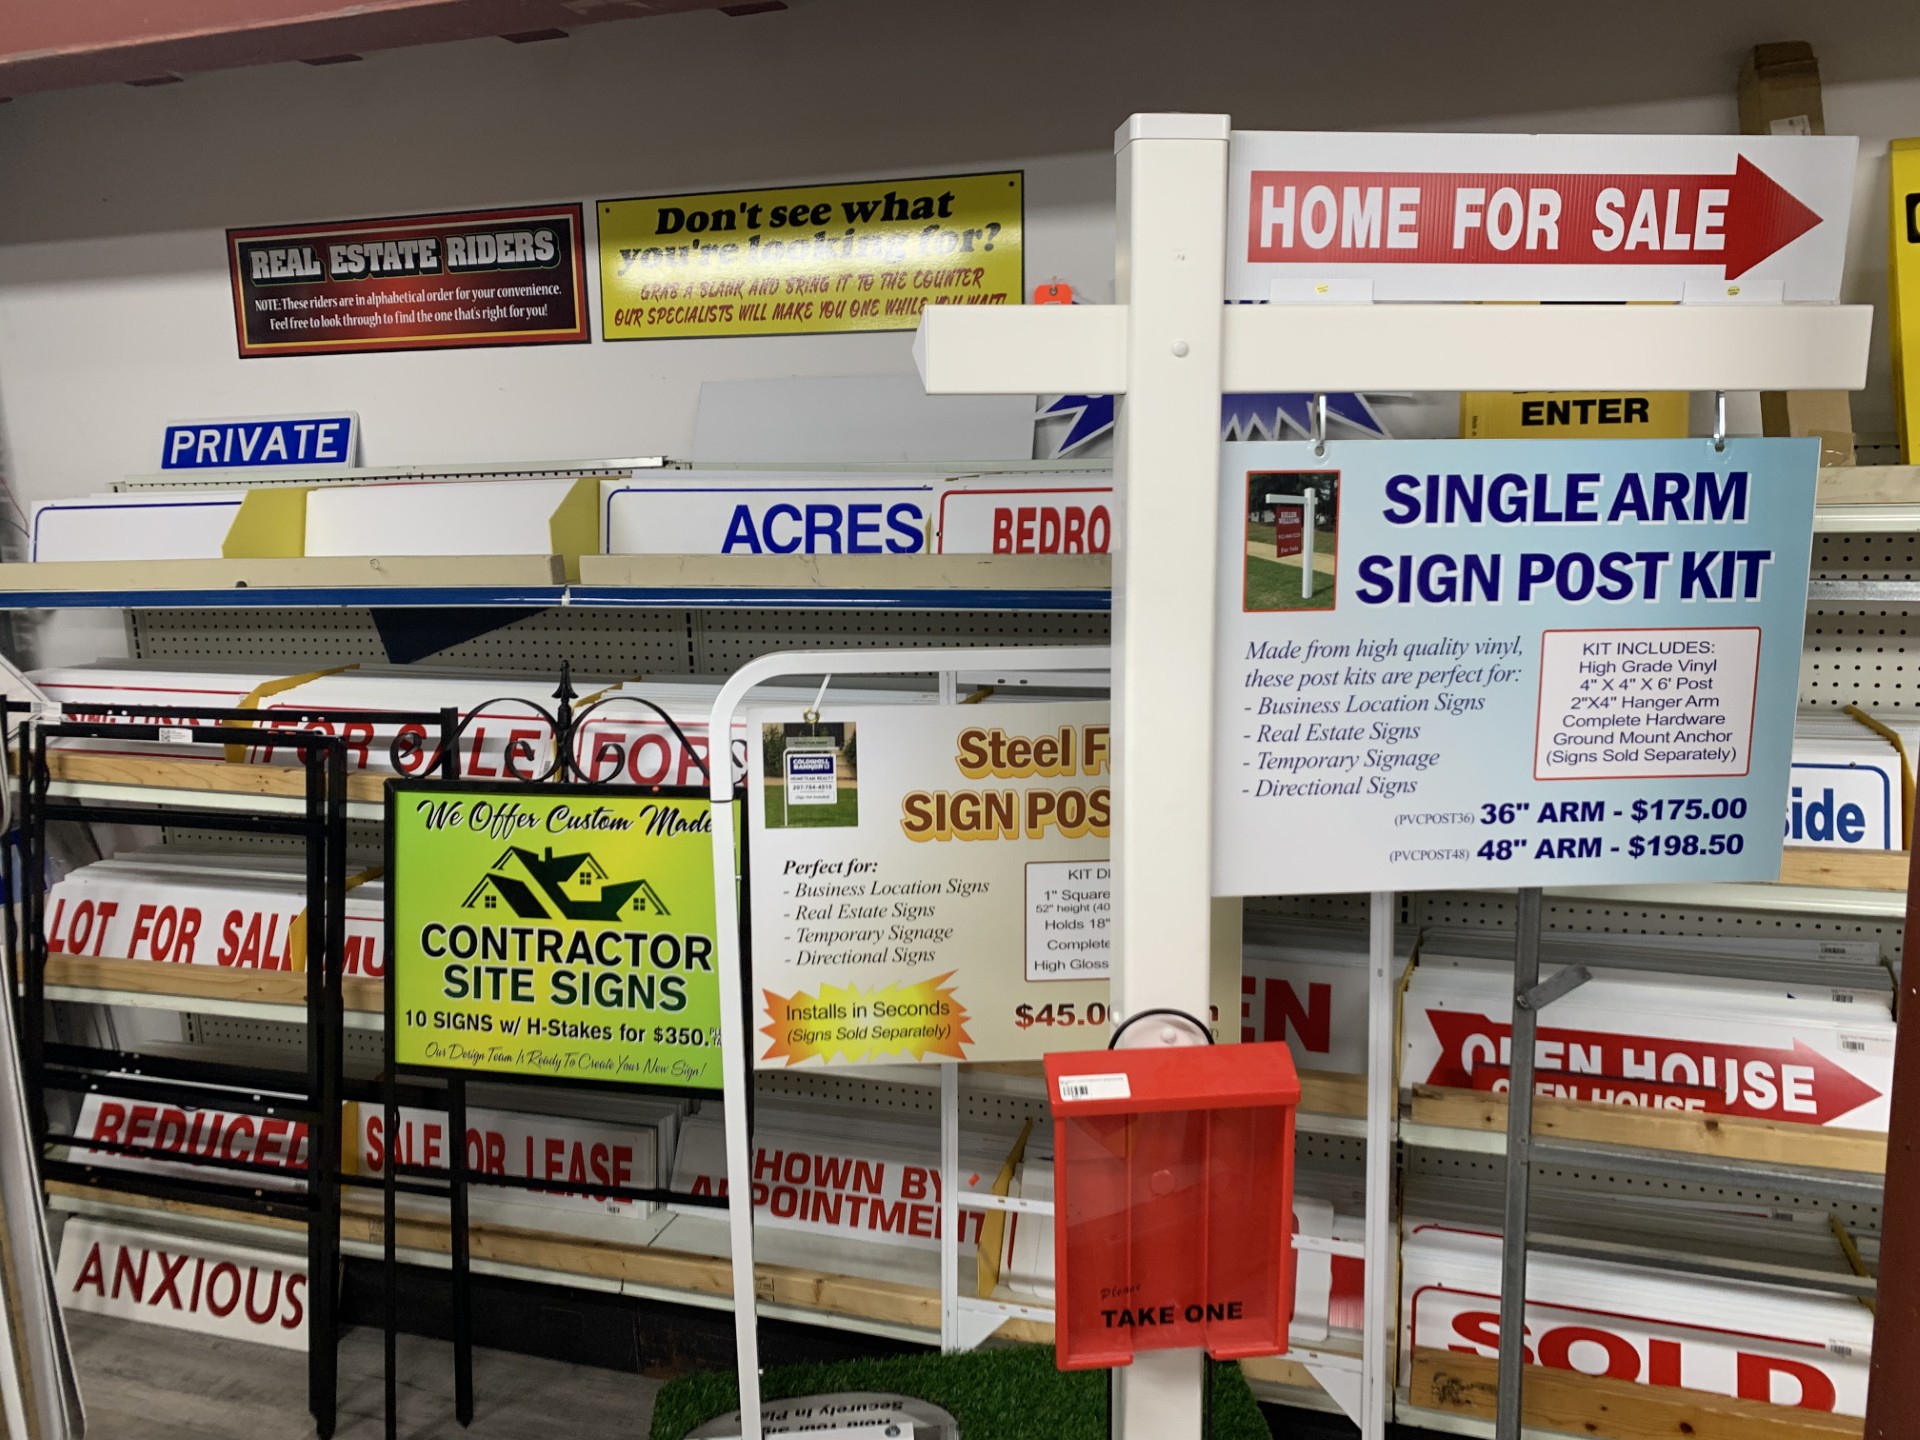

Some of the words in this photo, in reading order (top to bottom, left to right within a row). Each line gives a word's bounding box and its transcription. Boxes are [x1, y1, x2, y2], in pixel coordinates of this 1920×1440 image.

[655, 202, 763, 234] Don't
[769, 202, 832, 228] see
[841, 190, 955, 223] what
[1259, 185, 1421, 250] HOME
[1452, 187, 1562, 251] FOR
[1591, 187, 1731, 252] SALE
[250, 246, 323, 281] REAL
[328, 238, 439, 276] ESTATE
[445, 230, 556, 269] RIDERS
[618, 239, 740, 276] you're
[747, 227, 910, 265] looking
[918, 222, 1002, 255] for?
[255, 298, 281, 312] NOTE:
[281, 296, 308, 310] These
[309, 294, 338, 309] riders
[366, 289, 425, 308] alphabetical
[426, 288, 454, 302] order
[471, 288, 498, 302] your
[497, 283, 562, 298] convenience.
[641, 281, 681, 302] GRAB
[700, 279, 744, 299] BLANK
[748, 276, 780, 296] AND
[785, 274, 830, 295] BRING
[880, 271, 907, 290] THE
[913, 267, 985, 289] COUNTER
[270, 317, 288, 331] Feel
[289, 317, 308, 330] free
[321, 314, 343, 328] look
[343, 312, 382, 328] through
[394, 310, 415, 324] find
[454, 306, 481, 320] that's
[482, 305, 507, 323] right
[526, 303, 548, 320] you!
[614, 307, 644, 328] OUR
[647, 304, 734, 326] SPECIALISTS
[738, 303, 768, 322] WILL
[772, 301, 814, 323] MAKE
[819, 300, 847, 319] YOU
[850, 298, 880, 318] ONE
[885, 296, 929, 317] WHILE
[1521, 397, 1650, 426] ENTER
[170, 422, 342, 465] PRIVATE
[1382, 472, 1602, 526] SINGLE
[1607, 471, 1751, 524] ARM
[721, 501, 925, 554] ACRES
[1355, 552, 1504, 605] SIGN
[1517, 550, 1673, 602] POST
[1680, 549, 1774, 601] KIT
[1244, 640, 1301, 660] Made
[1301, 639, 1351, 663] from
[1355, 638, 1398, 662] high
[1403, 636, 1470, 661] quality
[1474, 635, 1523, 660] vinyl,
[1582, 642, 1612, 656] KIT
[1617, 641, 1715, 655] INCLUDES:
[1244, 669, 1294, 688] these
[1297, 670, 1340, 692] post
[1343, 666, 1377, 686] kits
[1381, 670, 1413, 685] are
[1415, 666, 1483, 689] perfect
[1483, 663, 1523, 687] for:
[1579, 660, 1616, 676] High
[1621, 660, 1673, 673] Grade
[1678, 659, 1717, 675] Vinyl
[1676, 677, 1713, 690] Post
[1257, 696, 1341, 715] Business
[1345, 694, 1429, 714] Location
[1434, 692, 1486, 715] Signs
[1621, 695, 1682, 711] Hanger
[1685, 694, 1719, 708] Arm
[1256, 723, 1302, 743] Real
[1305, 723, 1365, 742] Estate
[1369, 721, 1421, 744] Signs
[1562, 714, 1641, 730] Complete
[1646, 713, 1726, 726] Hardware
[957, 727, 1074, 774] Steel
[1553, 732, 1615, 746] Ground
[1619, 731, 1671, 744] Mount
[1673, 730, 1733, 743] Anchor
[1257, 751, 1359, 774] Temporary
[1364, 749, 1440, 772] Signage
[1546, 750, 1598, 766] (Signs
[1602, 748, 1639, 763] Sold
[1644, 747, 1737, 764] Separately)
[1255, 776, 1364, 797] Directional
[1366, 776, 1418, 799] Signs
[416, 800, 464, 832] We
[469, 801, 541, 840] Offer
[545, 804, 635, 834] Custom
[639, 804, 713, 837] Made
[902, 791, 1018, 838] SIGN
[1394, 811, 1475, 827] (PVCPOST36)
[1480, 802, 1530, 824] 36"
[1536, 801, 1605, 823] ARM
[1630, 797, 1748, 823] $175.00
[1389, 848, 1470, 864] (PVCPOST48)
[1476, 838, 1527, 861] 48"
[1534, 837, 1602, 859] ARM
[1627, 833, 1744, 859] $198.50
[783, 859, 844, 878] Perfect
[844, 858, 878, 878] for:
[1068, 869, 1093, 880] KIT
[794, 882, 866, 898] Business
[870, 880, 942, 896] Location
[946, 878, 990, 898] Signs
[1061, 889, 1110, 902] Square
[795, 904, 833, 920] Real
[837, 903, 888, 919] Estate
[891, 902, 936, 921] Signs
[1057, 903, 1090, 914] height
[49, 898, 119, 957] LOT
[127, 903, 202, 964] FOR
[796, 927, 884, 945] Temporary
[888, 924, 954, 944] Signage
[1045, 919, 1084, 930] Holds
[420, 922, 714, 972] CONTRACTOR
[796, 948, 889, 966] Directional
[892, 947, 936, 966] Signs
[1047, 938, 1110, 952] Complete
[1034, 959, 1066, 972] High
[1070, 958, 1109, 970] Gloss
[443, 964, 536, 1003] SITE
[549, 970, 688, 1012] SIGNS
[786, 1003, 847, 1021] Installs
[852, 1002, 867, 1018] in
[873, 1000, 950, 1017] Seconds
[1015, 1002, 1110, 1030] $45.0
[406, 1009, 427, 1027] 10
[433, 1011, 493, 1032] SIGNS
[500, 1016, 522, 1036] w/
[527, 1017, 612, 1040] H-Stakes
[619, 1023, 646, 1042] for
[653, 1026, 709, 1046] $350.
[787, 1028, 832, 1045] (Signs
[836, 1026, 868, 1041] Sold
[871, 1024, 951, 1041] Separately)
[448, 1043, 485, 1066] Design
[525, 1049, 562, 1072] Ready
[1622, 1048, 1817, 1115] HOUSE
[526, 1135, 633, 1204] LEASE
[754, 1147, 885, 1195] HOWN
[73, 1241, 308, 1330] ANXIOUS
[1101, 1305, 1175, 1328] TAKE
[1184, 1301, 1244, 1324] ONE
[1447, 1310, 1836, 1412] SOLD
